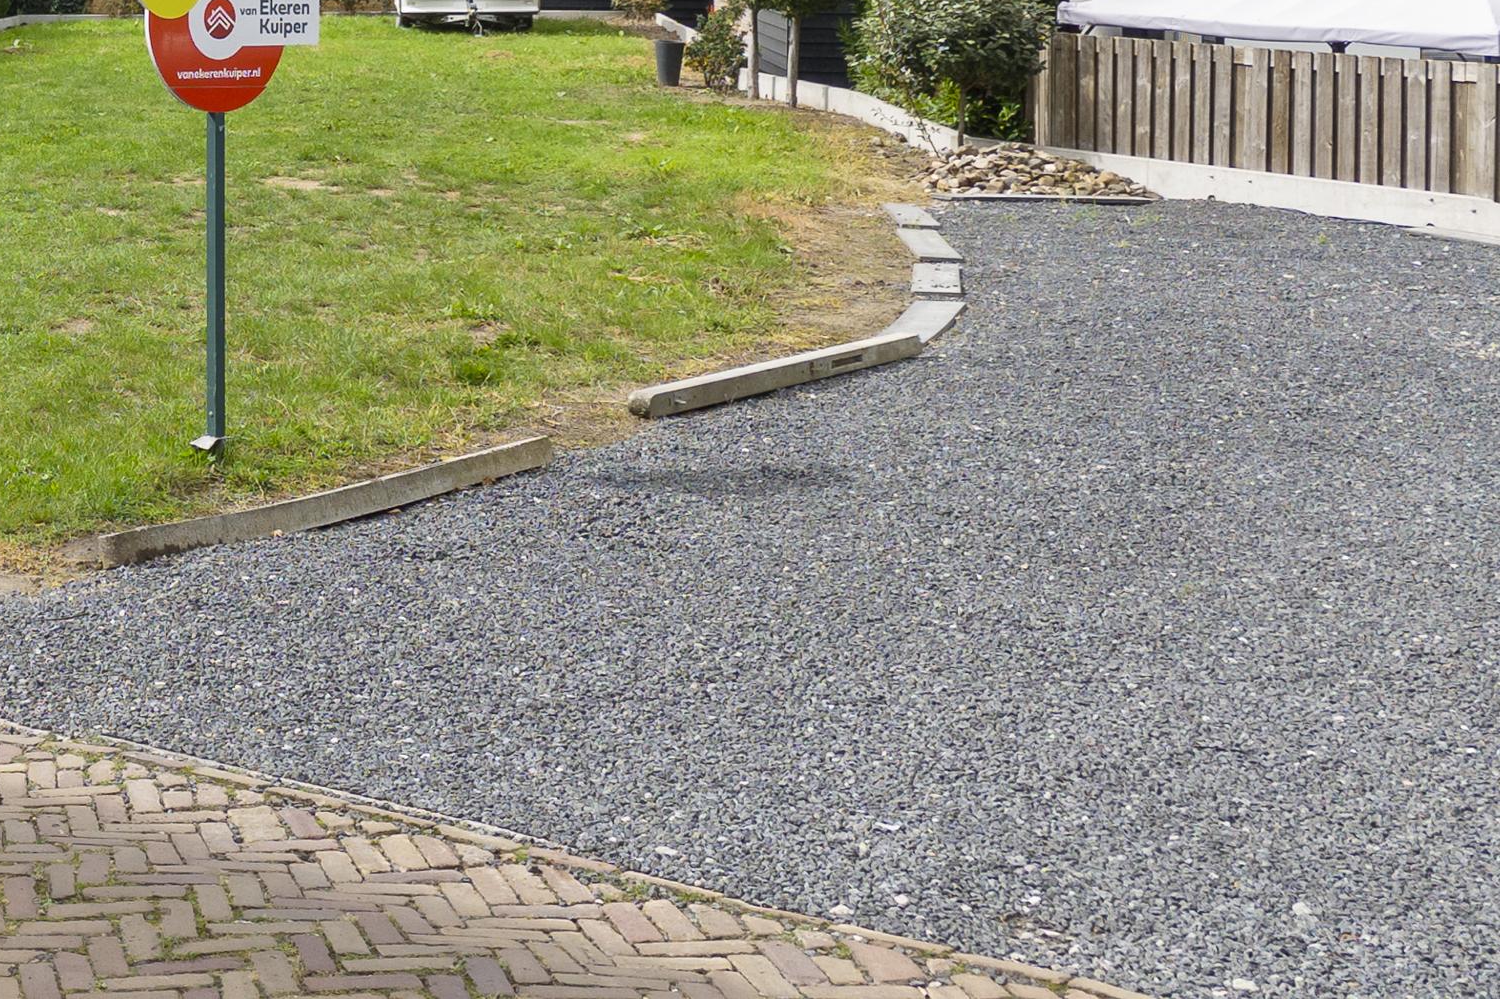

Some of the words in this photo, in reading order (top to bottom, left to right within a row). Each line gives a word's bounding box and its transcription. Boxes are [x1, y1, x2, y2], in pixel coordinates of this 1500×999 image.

[240, 7, 257, 16] van
[259, 0, 310, 15] Ekeren
[259, 18, 308, 38] Kuiper
[177, 67, 261, 81] vanekerenkuiper.nl
